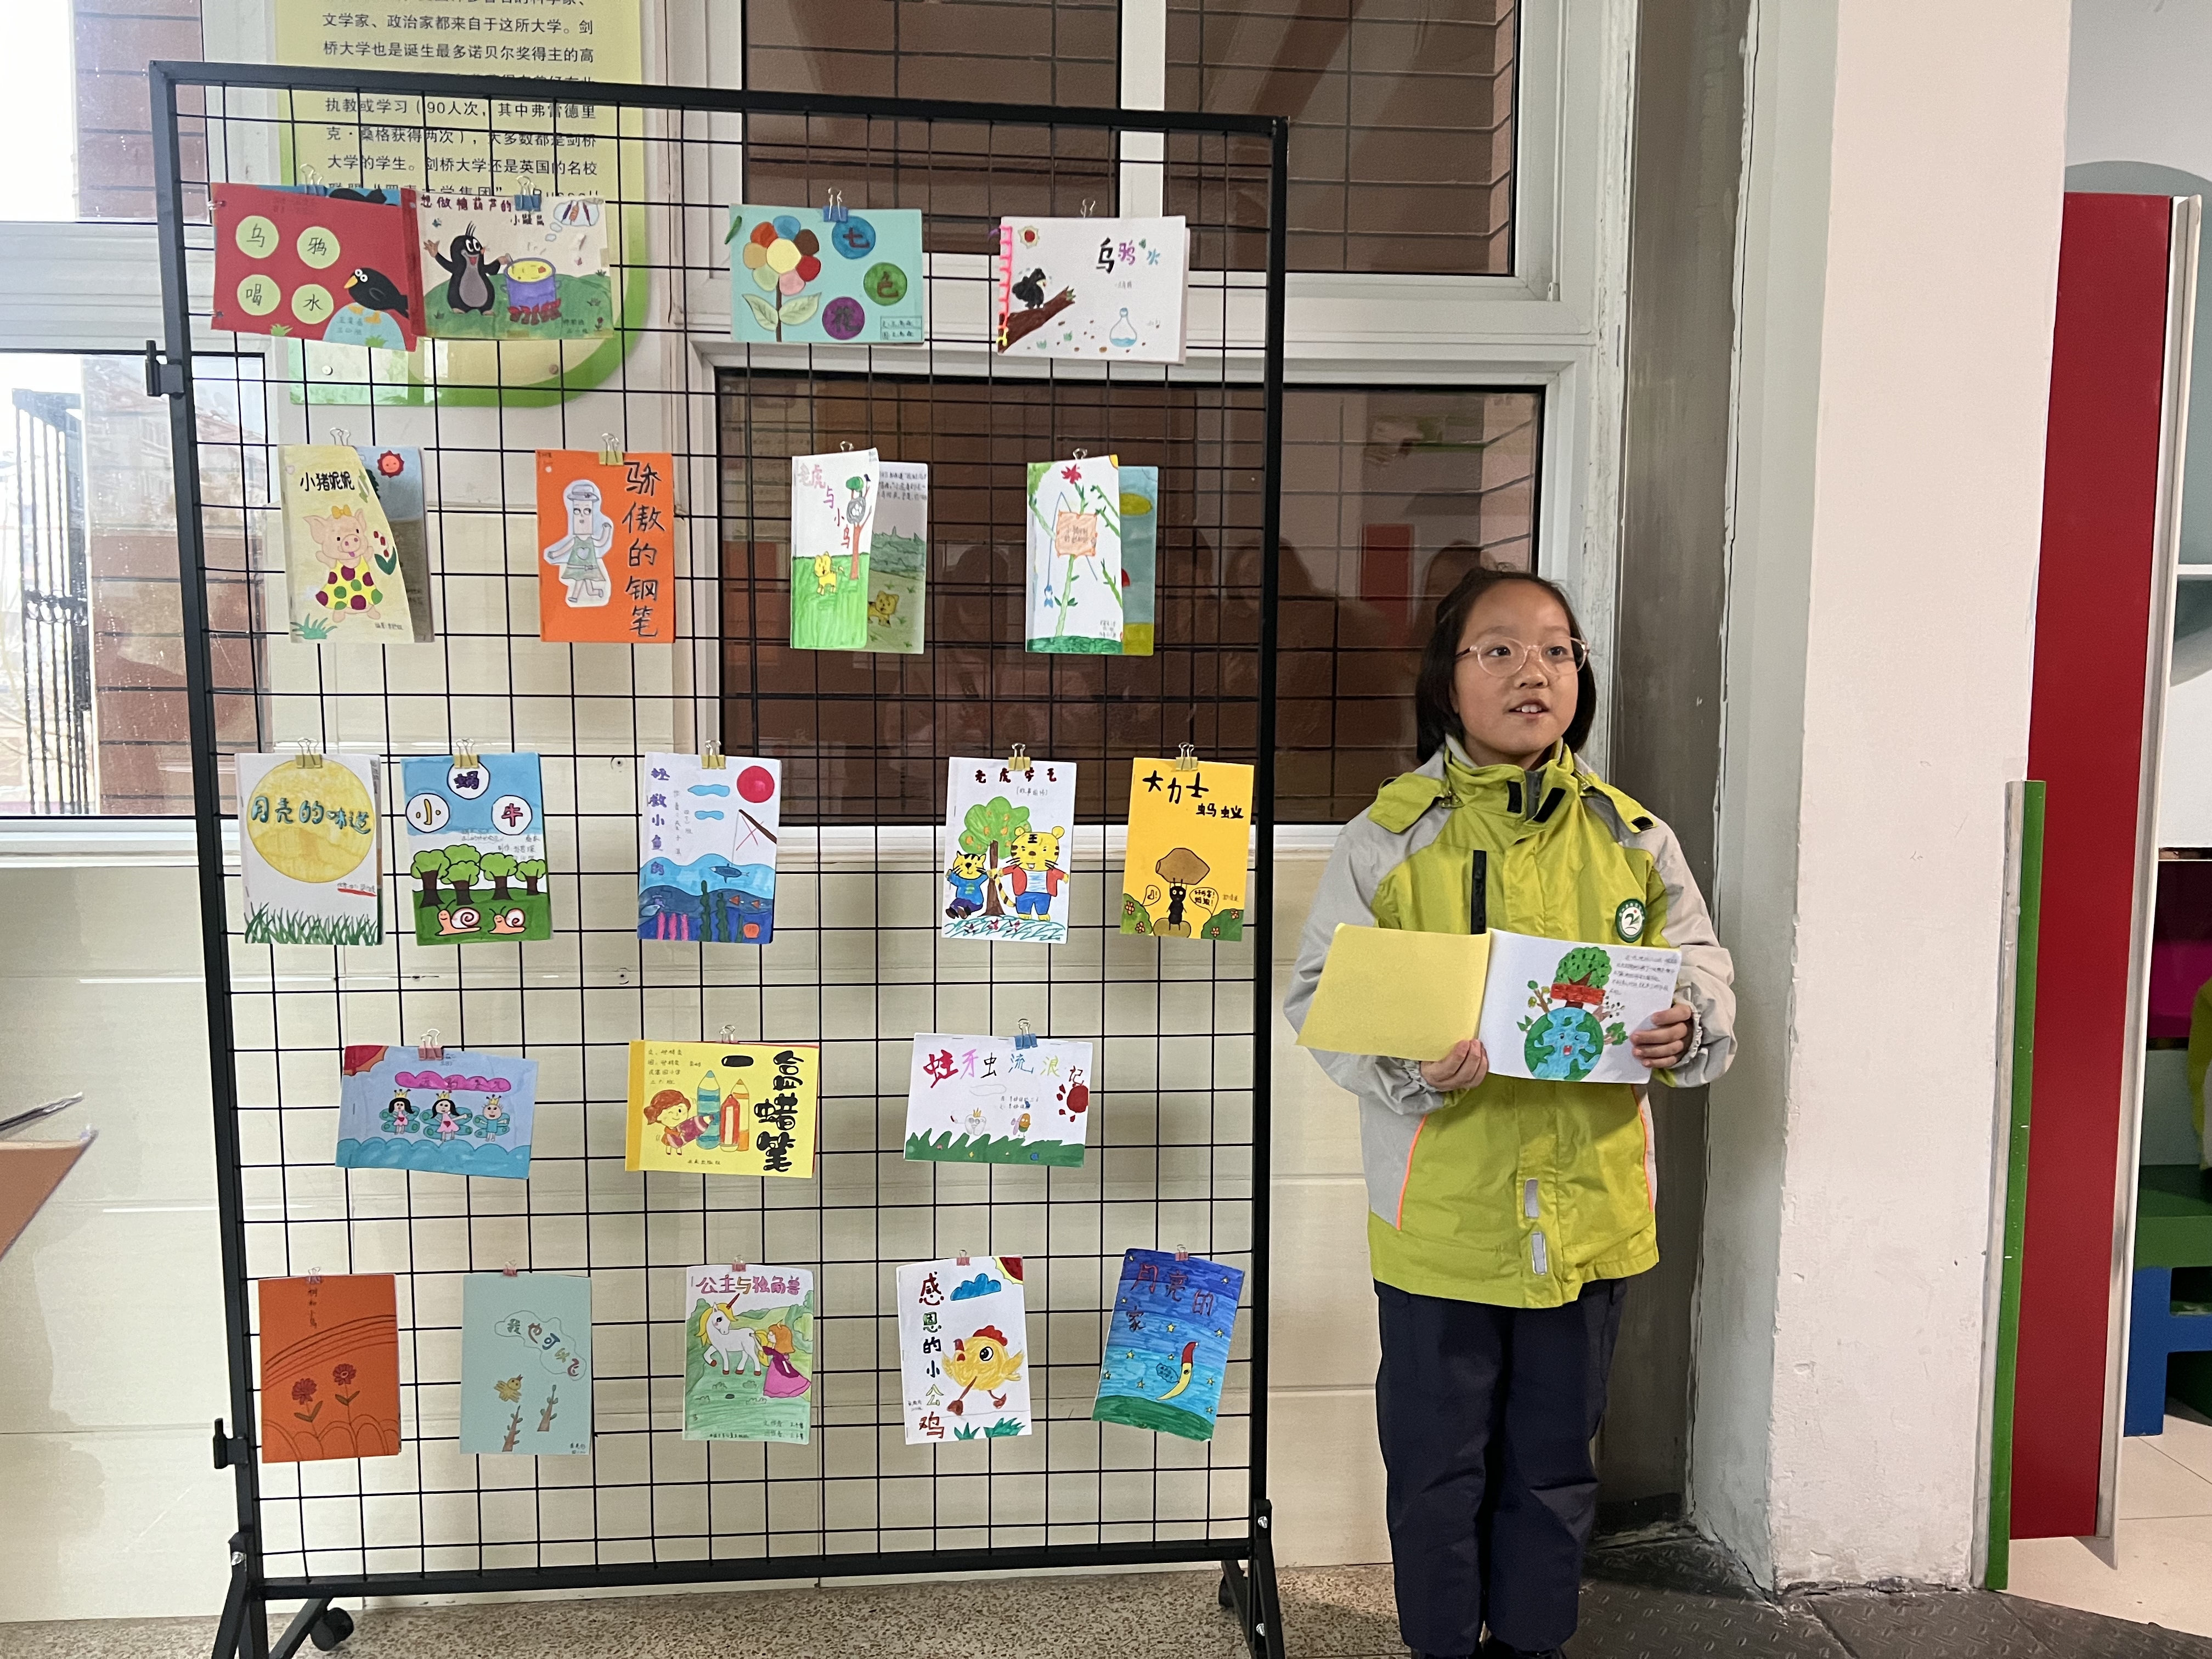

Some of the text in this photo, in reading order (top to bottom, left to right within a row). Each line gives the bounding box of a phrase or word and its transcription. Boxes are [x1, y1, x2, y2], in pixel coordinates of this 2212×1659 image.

[322, 13, 593, 35] 文学家、政治家都来自于这所大学。剑
[323, 41, 594, 63] 桥大学也是诞生最多诺贝尔奖得主的高
[328, 154, 597, 176] 大学的学生。剑桥大学还是英国的名校
[300, 471, 355, 492] 小猪妮妮
[622, 461, 665, 637] 骄傲的钢笔
[1142, 770, 1209, 804] 大力士
[251, 796, 371, 834] 月亮的味道
[1195, 803, 1244, 819] 蚂蚁
[696, 1274, 800, 1295] 公主与独角兽
[918, 1271, 945, 1439] 感恩的小公鸡
